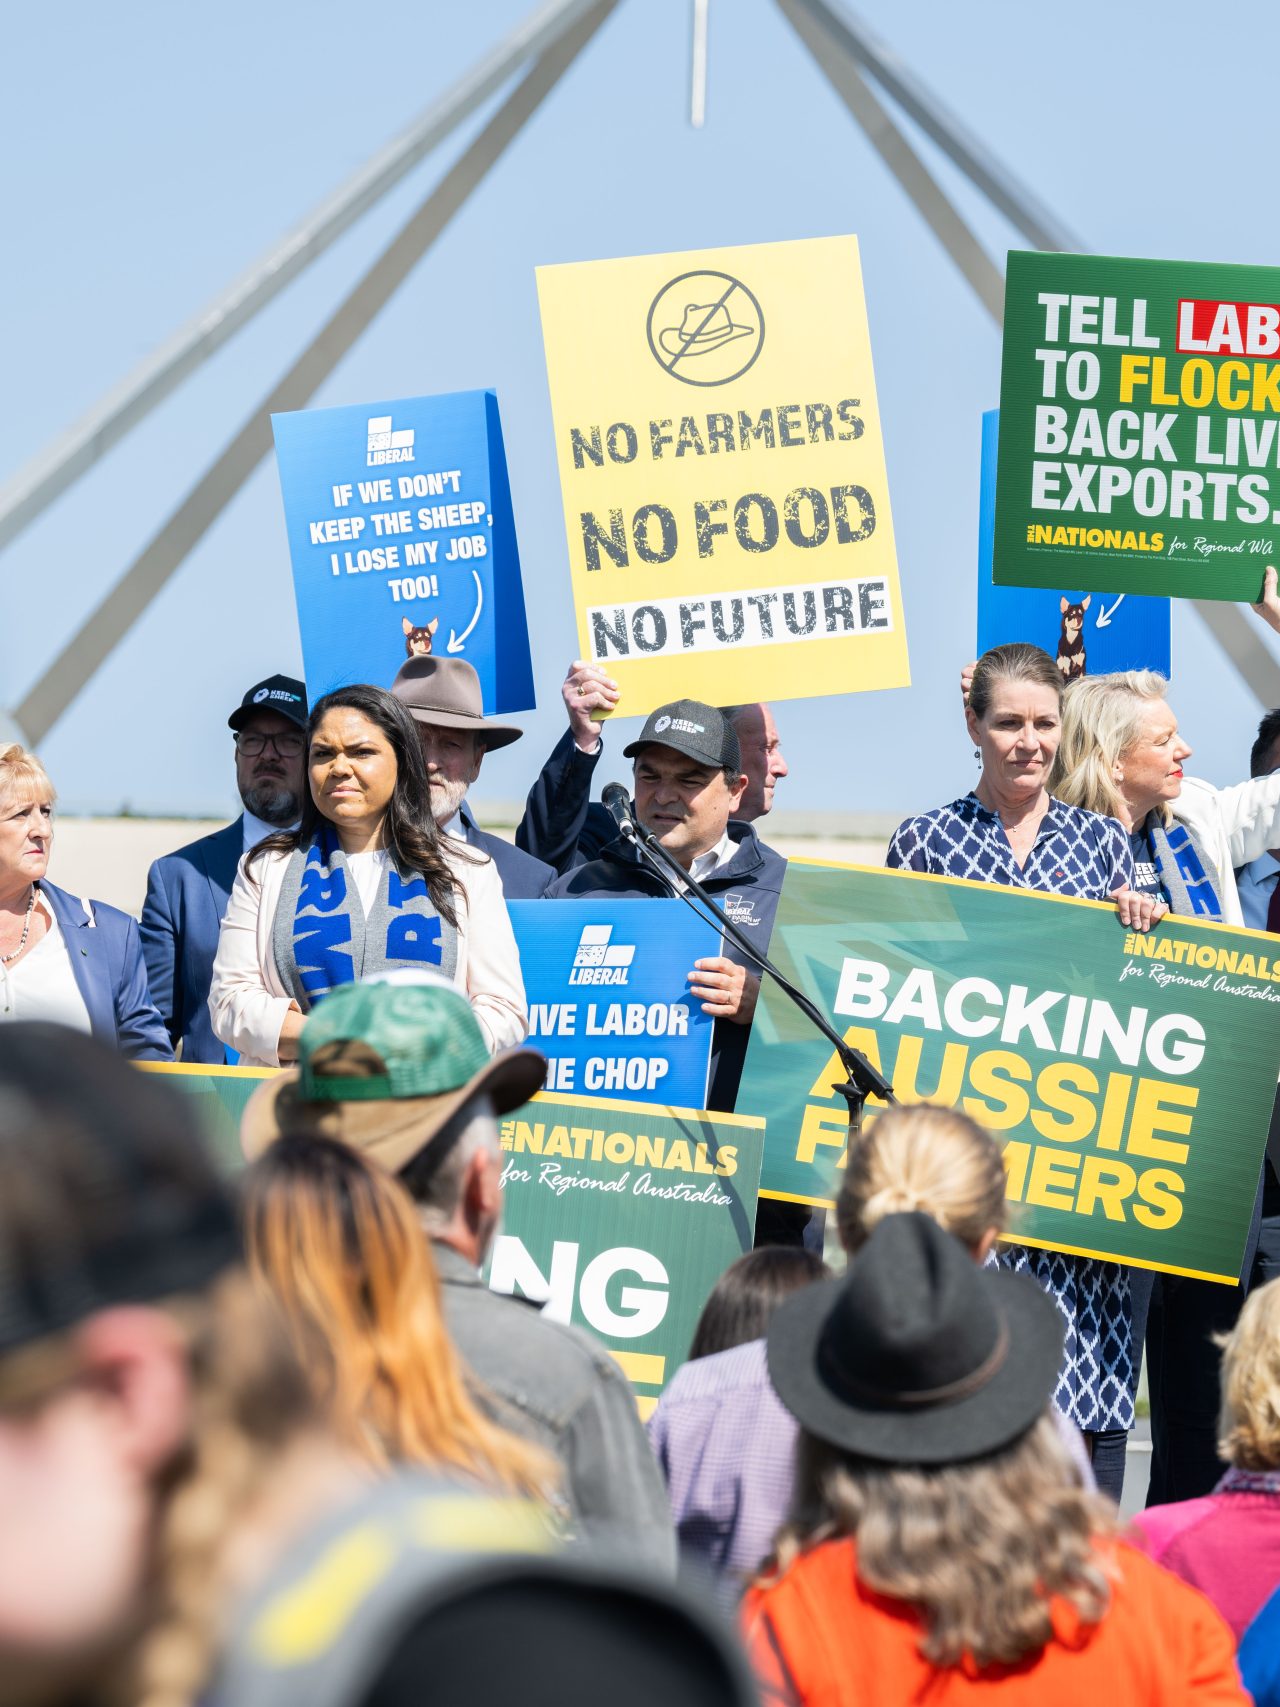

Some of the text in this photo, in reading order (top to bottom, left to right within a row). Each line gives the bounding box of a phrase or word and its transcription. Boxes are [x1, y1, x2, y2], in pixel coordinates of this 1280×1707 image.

[1037, 293, 1160, 349] TELL
[1035, 349, 1101, 401] TO
[569, 398, 866, 470] NO FARMERS
[1034, 405, 1179, 462] BACK
[366, 446, 416, 467] LIBERAL
[332, 470, 462, 507] IF WE DON'T
[309, 501, 494, 545] KEEP THE SHEEP,
[580, 484, 877, 572] NO FOOD
[1027, 525, 1036, 543] THE
[1035, 525, 1165, 552] NATIONALS
[1168, 535, 1188, 556] for
[1193, 536, 1245, 557] Regional
[1249, 539, 1274, 555] WA
[330, 535, 487, 576] I LOSE MY JOB
[387, 575, 439, 602] TOO!
[591, 581, 889, 658] NO FUTURE
[1135, 863, 1156, 875] EEP
[1123, 933, 1137, 955] THE
[568, 967, 629, 986] LIBERAL
[1118, 959, 1145, 983] for
[1148, 962, 1213, 988] Regional
[528, 1002, 690, 1037] IVE LABOR
[832, 957, 1206, 1076] BACKING
[583, 1056, 669, 1091] CHOP
[500, 1121, 739, 1177] THE NATIONALS
[498, 1159, 734, 1206] for Regional Australia
